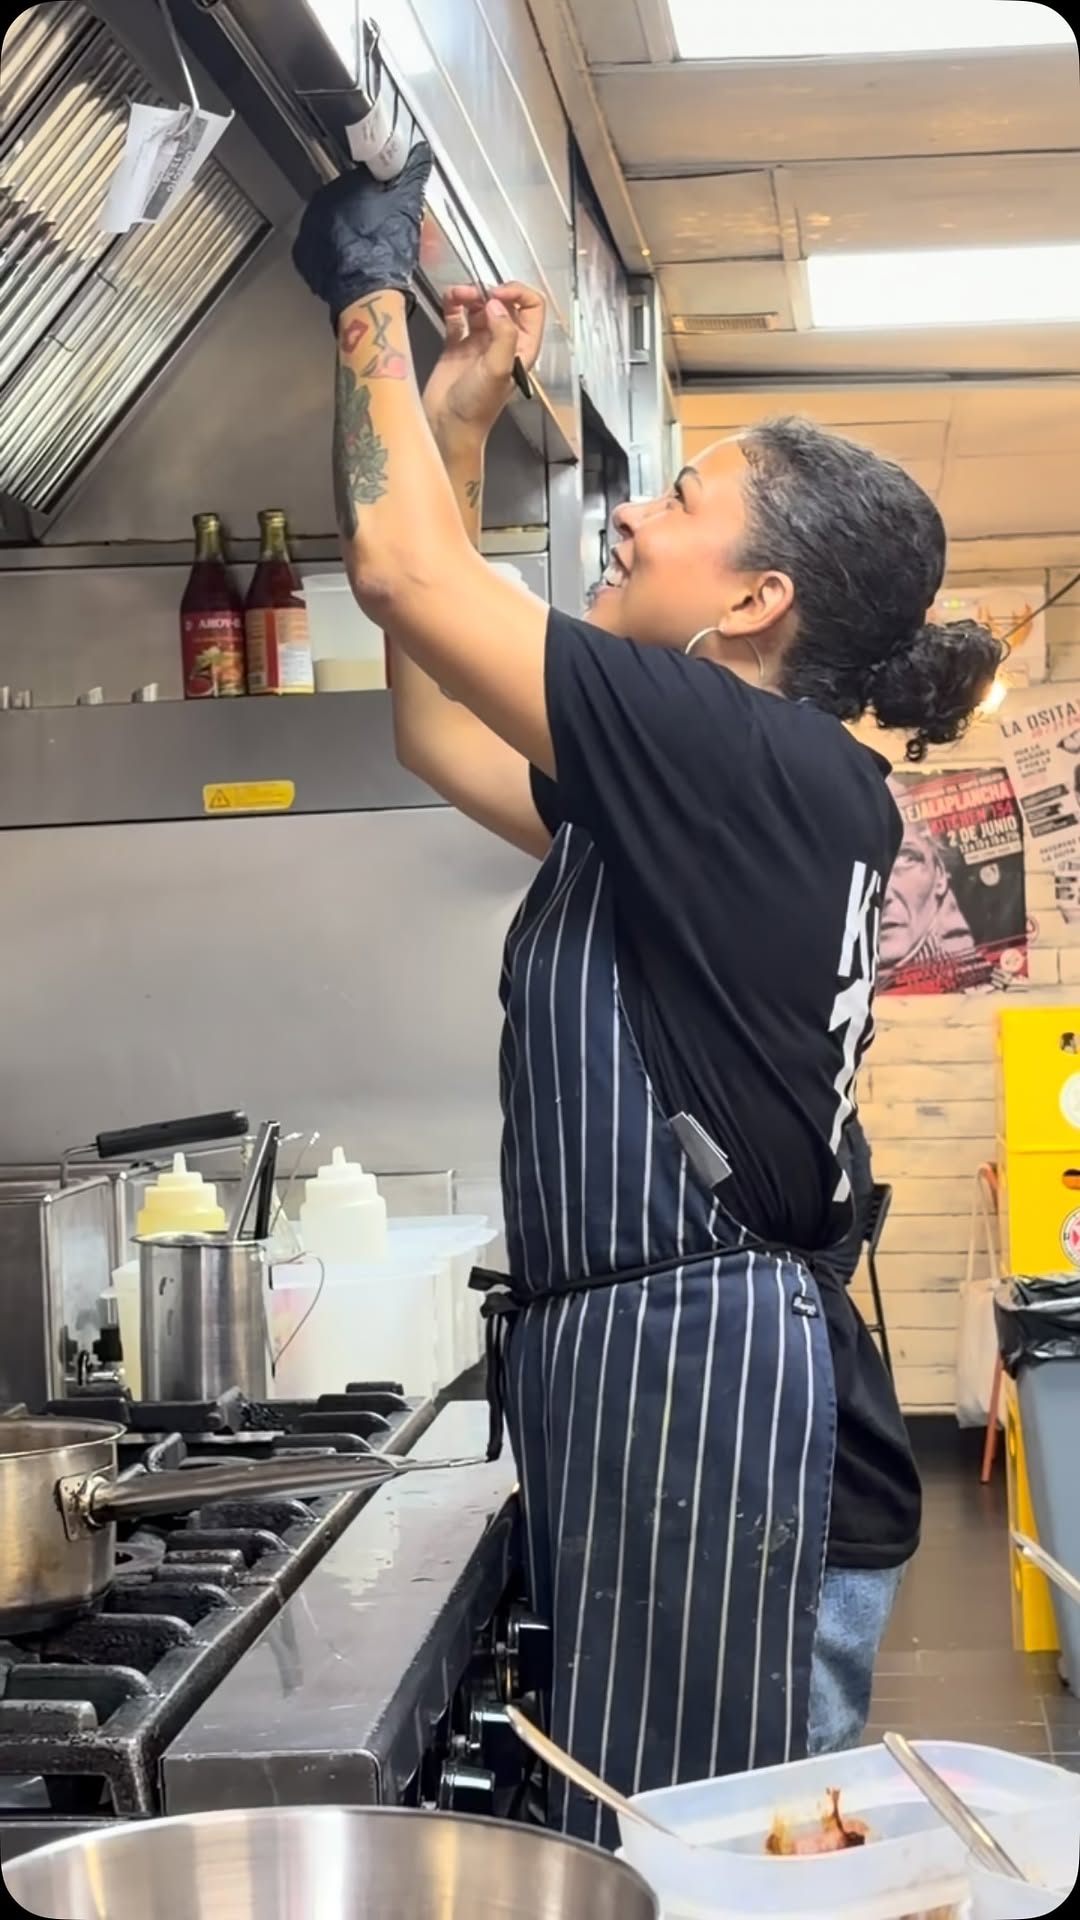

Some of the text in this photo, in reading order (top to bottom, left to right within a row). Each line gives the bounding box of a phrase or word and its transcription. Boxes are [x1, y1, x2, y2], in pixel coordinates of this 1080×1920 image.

[1001, 720, 1022, 738] LA
[1026, 702, 1077, 730] OSITA
[947, 830, 957, 848] 2
[960, 824, 978, 843] DE
[980, 815, 1017, 839] JUNIO
